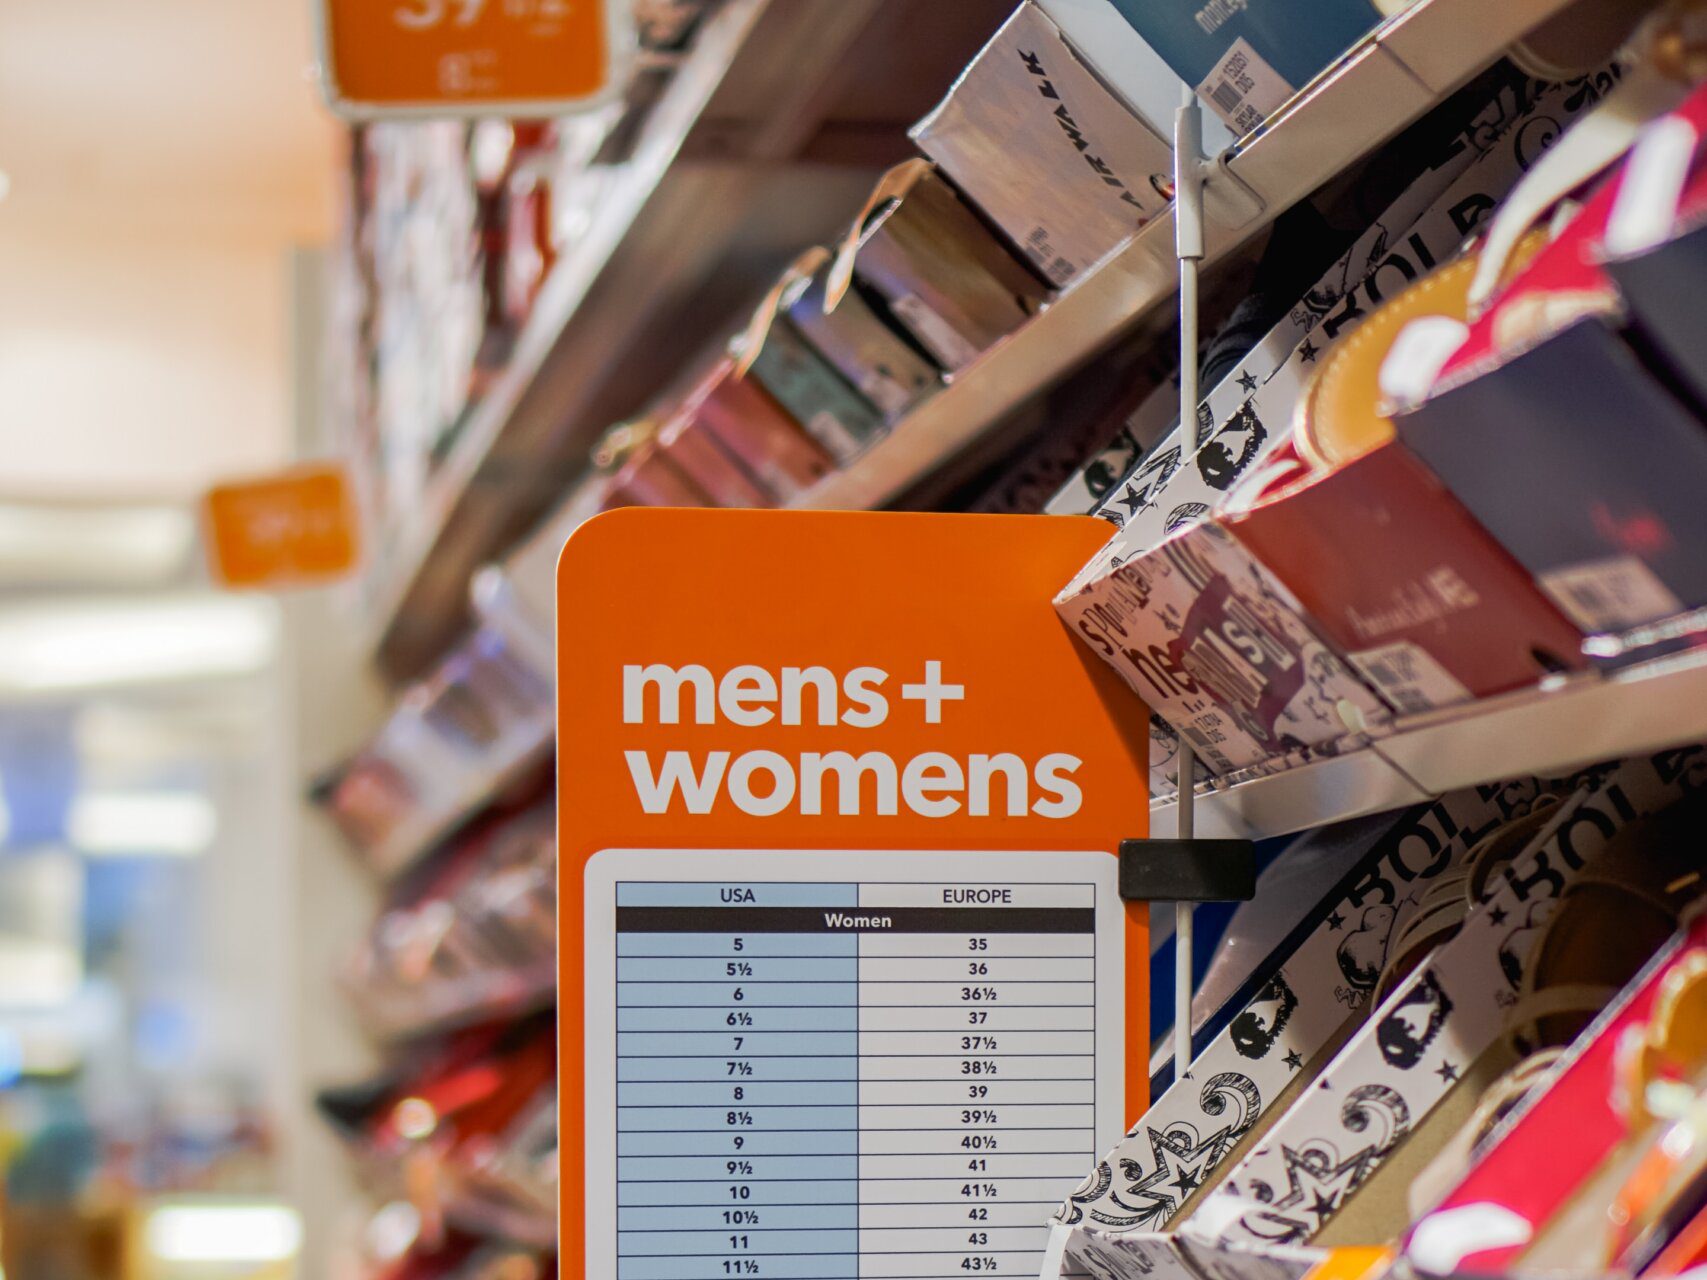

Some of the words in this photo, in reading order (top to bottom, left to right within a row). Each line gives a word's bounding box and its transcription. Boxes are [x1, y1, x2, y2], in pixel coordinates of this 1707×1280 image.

[1016, 48, 1145, 211] AIRWALK
[624, 749, 1083, 819] womens
[720, 888, 756, 903] USA
[943, 889, 1012, 904] EUROPE
[824, 913, 892, 928] Women
[733, 937, 744, 952] 5
[968, 938, 988, 951] 35
[968, 962, 988, 976] 36
[733, 987, 744, 1001] 6
[968, 1011, 988, 1025] 37
[733, 1037, 744, 1051] 7
[733, 1086, 744, 1101] 8
[968, 1085, 988, 1098] 39
[733, 1136, 744, 1150] 9
[968, 1159, 986, 1172] 41
[729, 1185, 750, 1200] 10
[968, 1208, 988, 1221] 42
[729, 1235, 748, 1249] 11
[968, 1232, 988, 1245] 43
